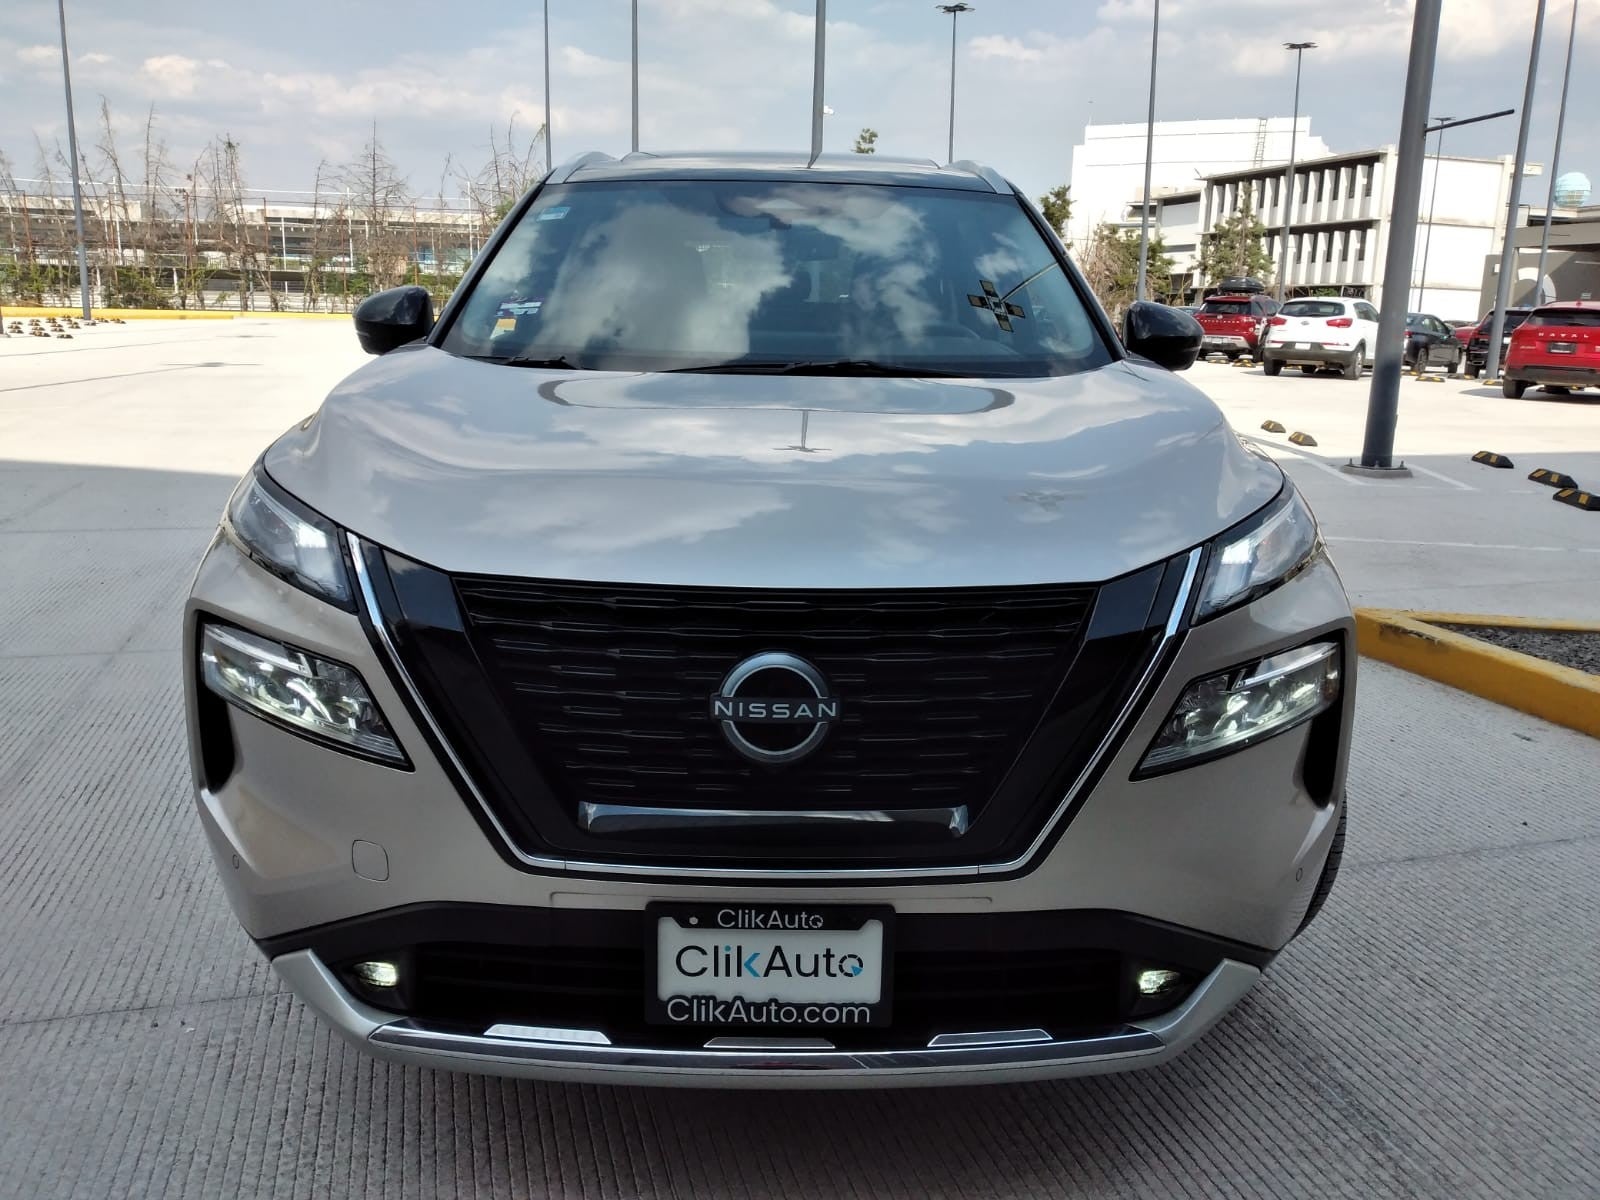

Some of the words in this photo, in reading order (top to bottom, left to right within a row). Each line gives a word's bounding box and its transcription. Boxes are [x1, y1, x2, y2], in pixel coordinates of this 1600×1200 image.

[714, 700, 836, 718] NISSAN
[717, 909, 824, 929] ClikAuto
[675, 945, 864, 978] ClikAuto
[667, 998, 871, 1024] ClikAuto.com
